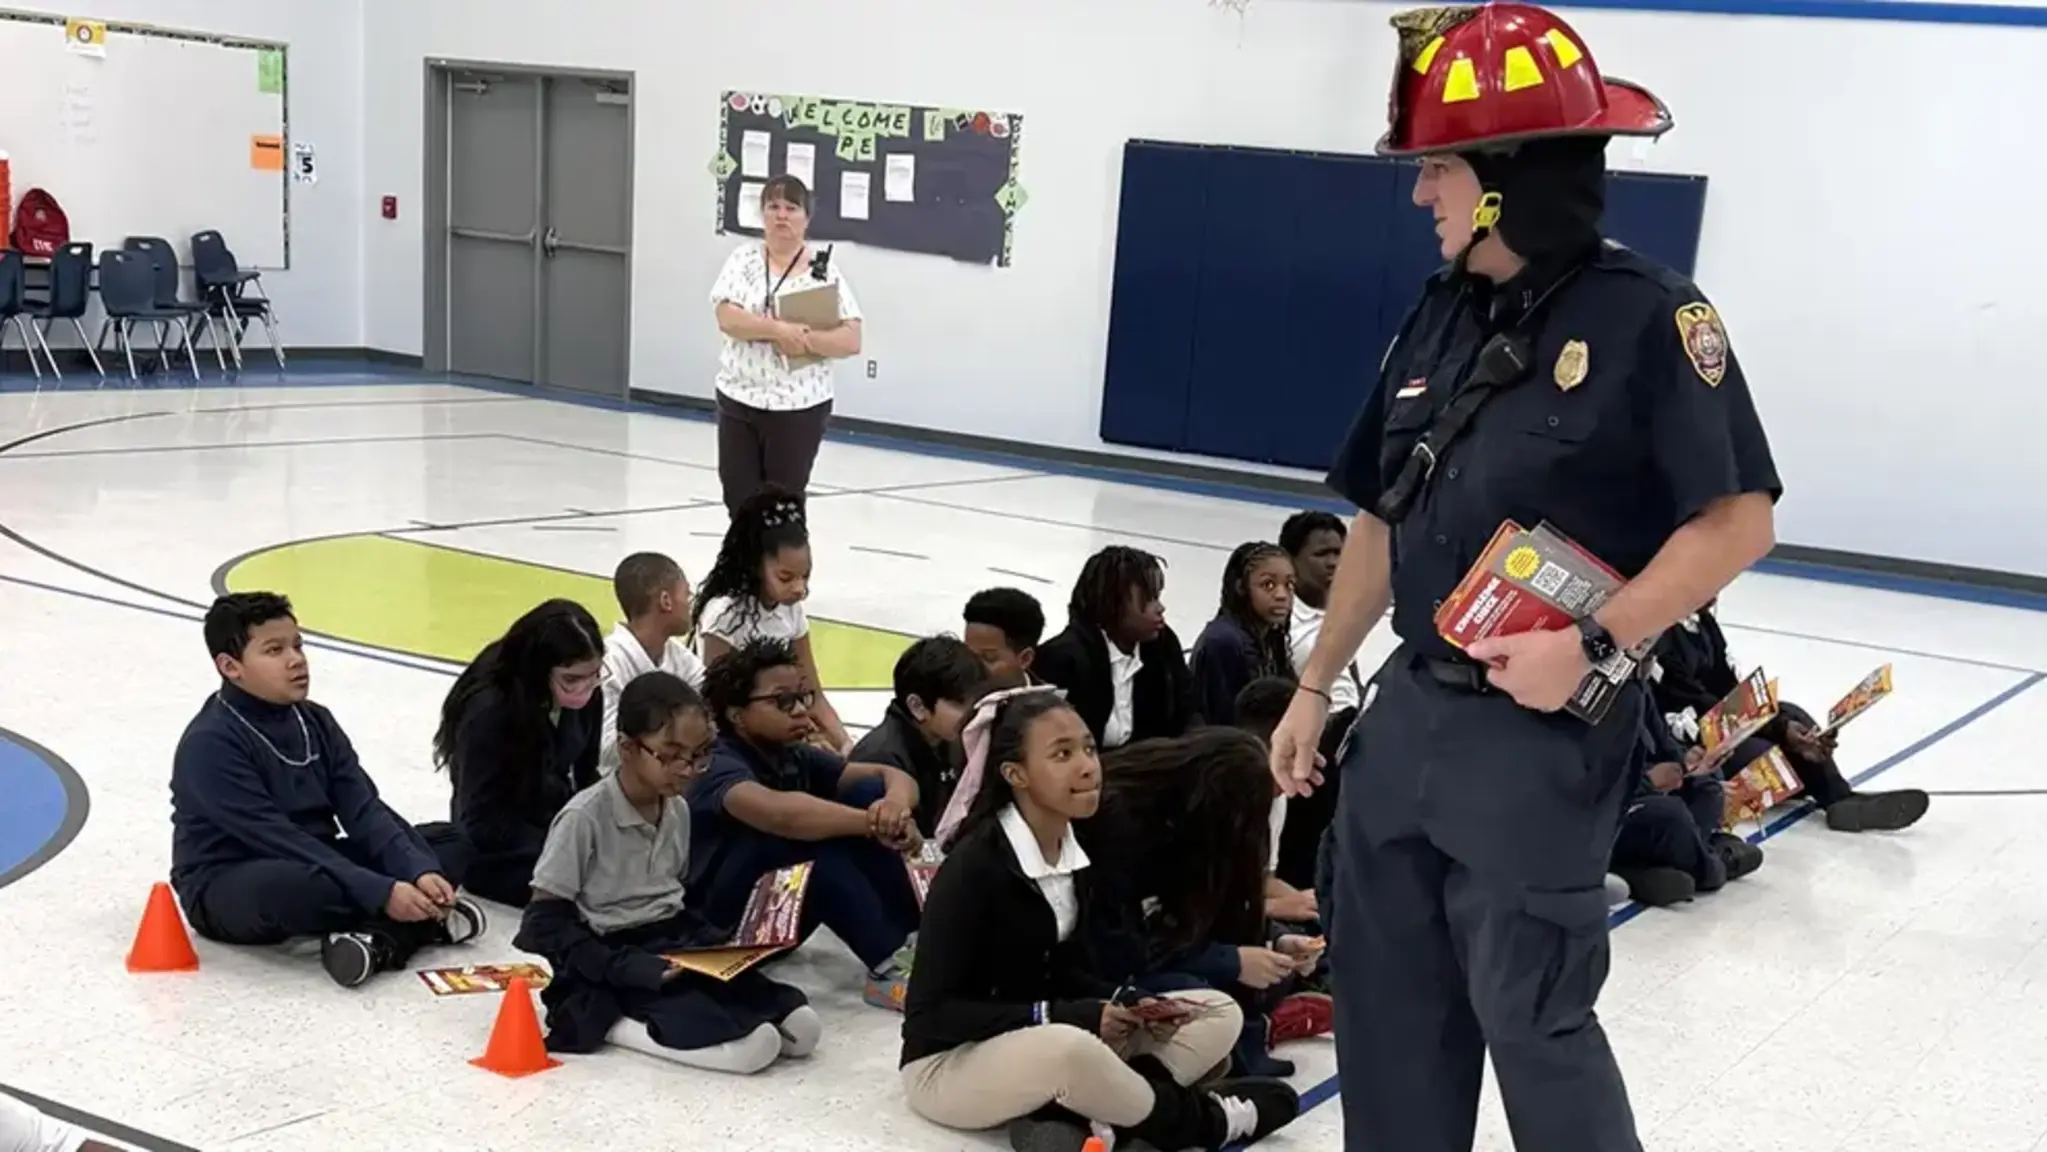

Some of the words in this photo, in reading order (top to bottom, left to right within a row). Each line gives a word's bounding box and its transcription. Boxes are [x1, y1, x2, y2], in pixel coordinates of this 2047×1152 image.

[786, 103, 906, 130] WELCOME
[840, 135, 873, 154] PE
[302, 157, 313, 174] 5
